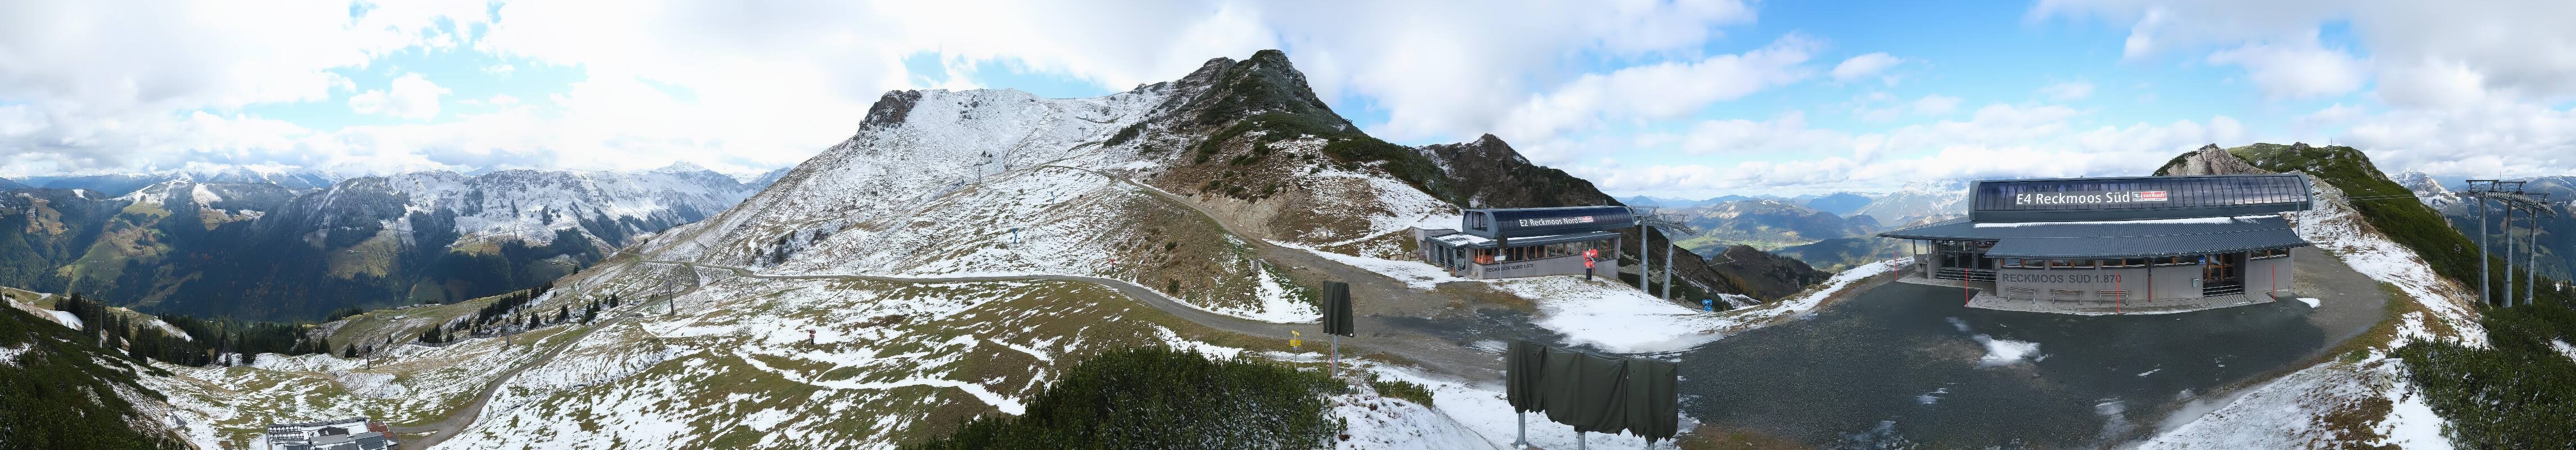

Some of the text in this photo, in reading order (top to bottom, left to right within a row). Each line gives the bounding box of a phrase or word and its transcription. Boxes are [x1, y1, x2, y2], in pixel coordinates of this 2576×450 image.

[2017, 191, 2130, 204] E4 Reckmoos Süd
[2002, 273, 2121, 283] RECKMOOS SÜD 1.870
